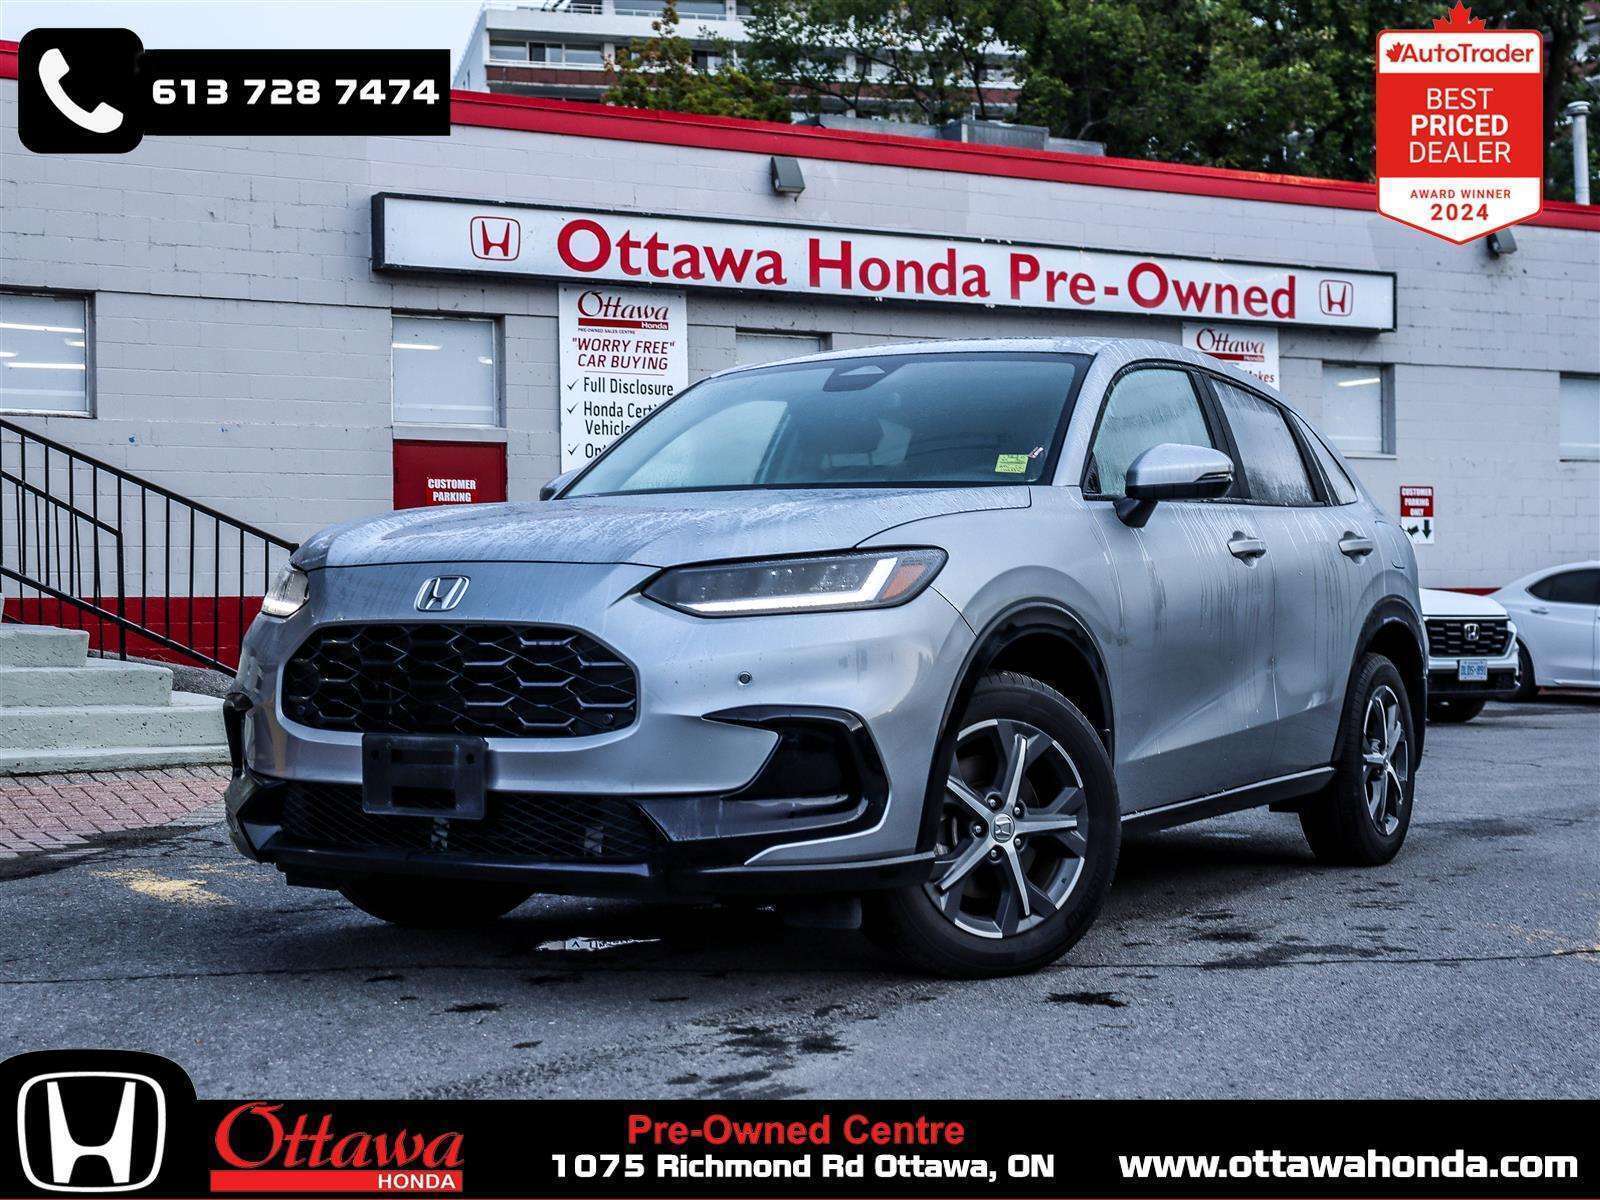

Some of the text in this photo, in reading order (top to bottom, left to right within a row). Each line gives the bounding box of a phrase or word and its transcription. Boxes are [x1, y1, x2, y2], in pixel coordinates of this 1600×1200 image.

[557, 219, 1297, 320] Ottawa Honda Pre-Owned
[577, 290, 668, 320] Ottawa
[641, 321, 668, 330] Honda
[572, 337, 675, 355] "WORRY FREE"
[1196, 328, 1264, 353] Ottawa
[577, 353, 668, 371] CAR BUYING
[583, 377, 674, 396] Full Disclosure
[583, 401, 623, 418] Honda
[427, 479, 476, 490] CUSTOMER
[1401, 488, 1432, 496] CUSTOMER
[432, 492, 471, 502] PARKING
